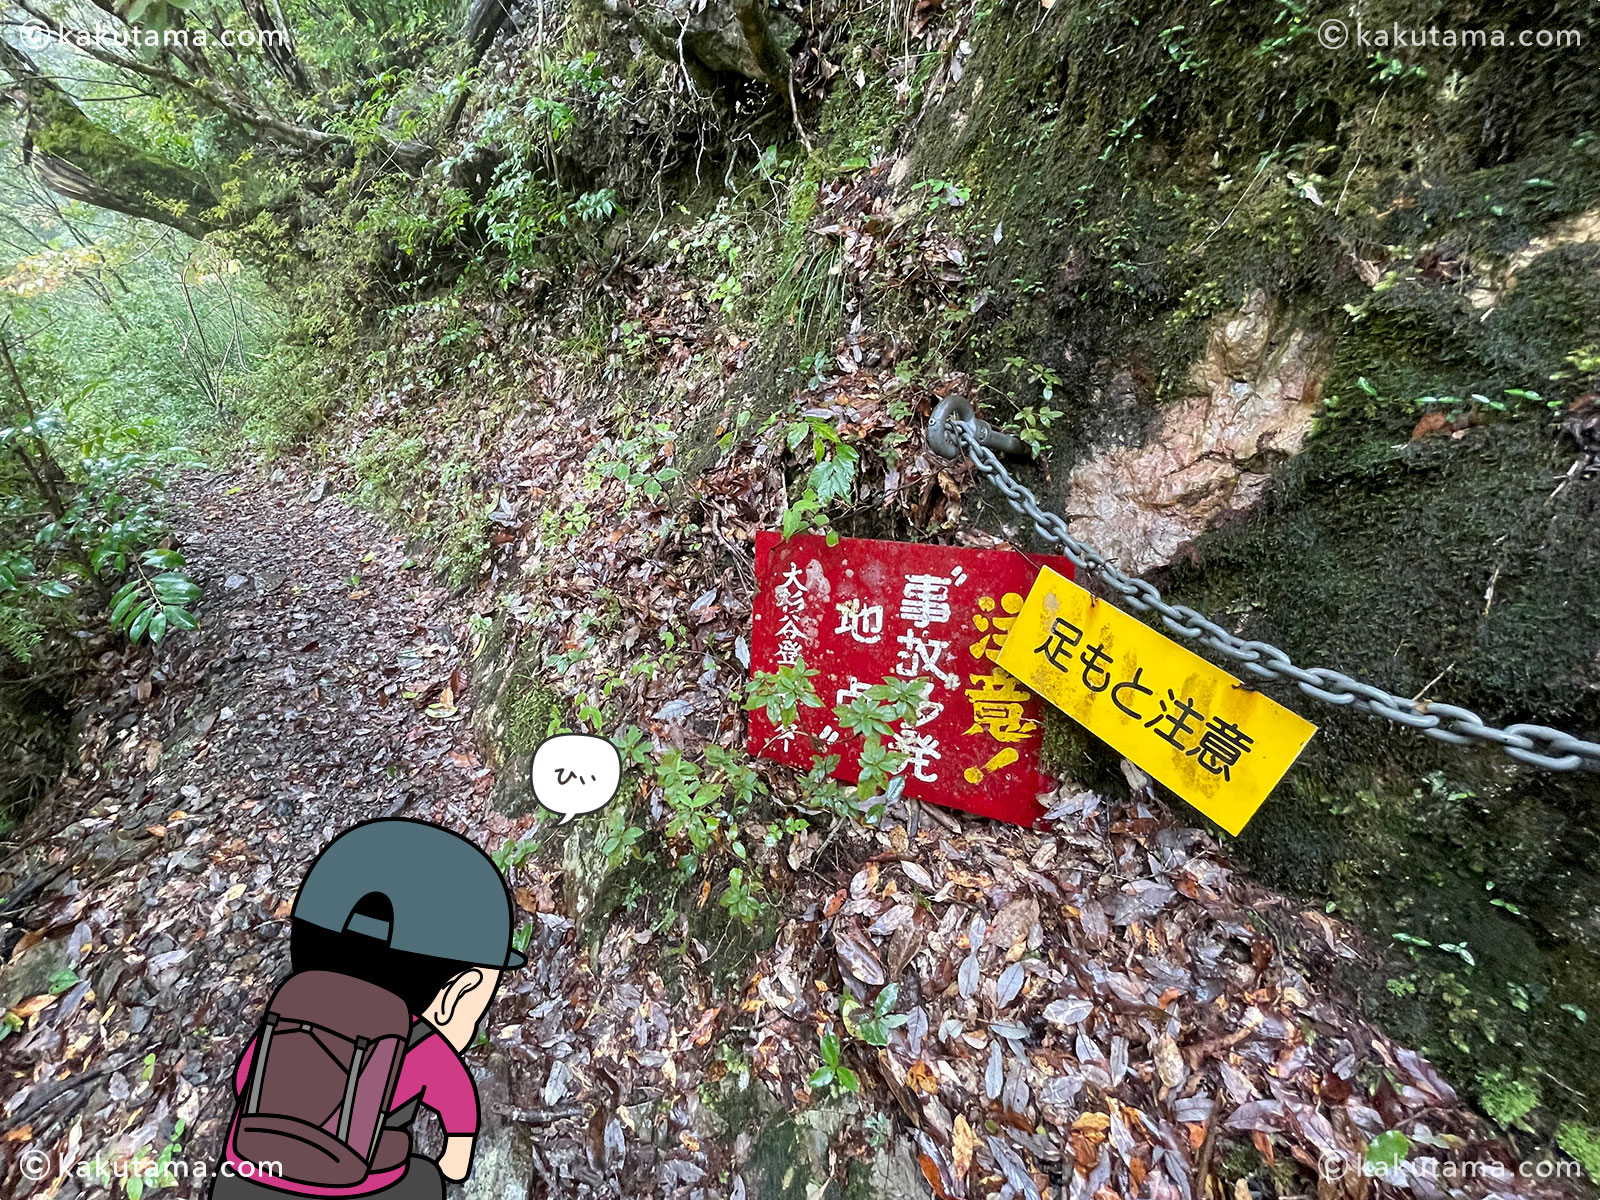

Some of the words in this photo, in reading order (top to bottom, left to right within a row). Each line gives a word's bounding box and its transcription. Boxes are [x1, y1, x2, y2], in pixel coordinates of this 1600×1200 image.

[1033, 617, 1254, 782] 足もと注意
